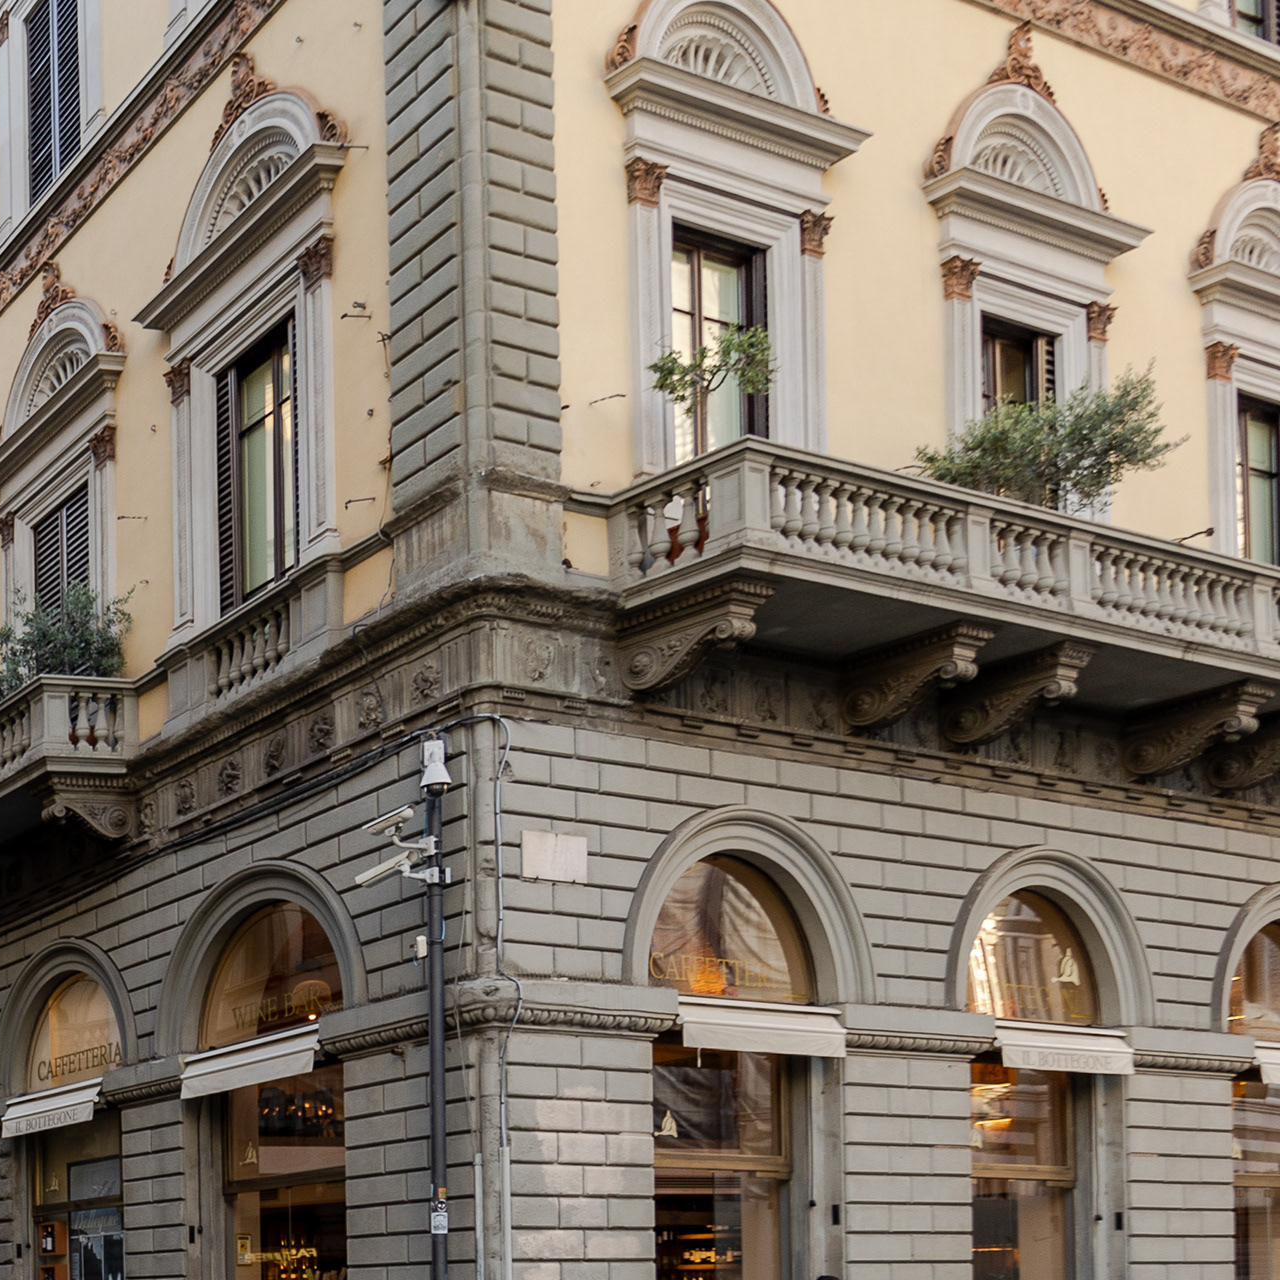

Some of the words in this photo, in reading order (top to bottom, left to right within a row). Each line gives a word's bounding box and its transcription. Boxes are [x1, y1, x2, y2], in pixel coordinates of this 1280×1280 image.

[232, 996, 279, 1030] WINE
[284, 983, 326, 1017] BAR
[37, 1040, 122, 1081] CAFFETTERIA
[1022, 1050, 1035, 1067] IL
[1037, 1051, 1114, 1072] BOTTEGONE
[14, 1121, 24, 1135] IL
[25, 1107, 79, 1131] BOTTEGONE
